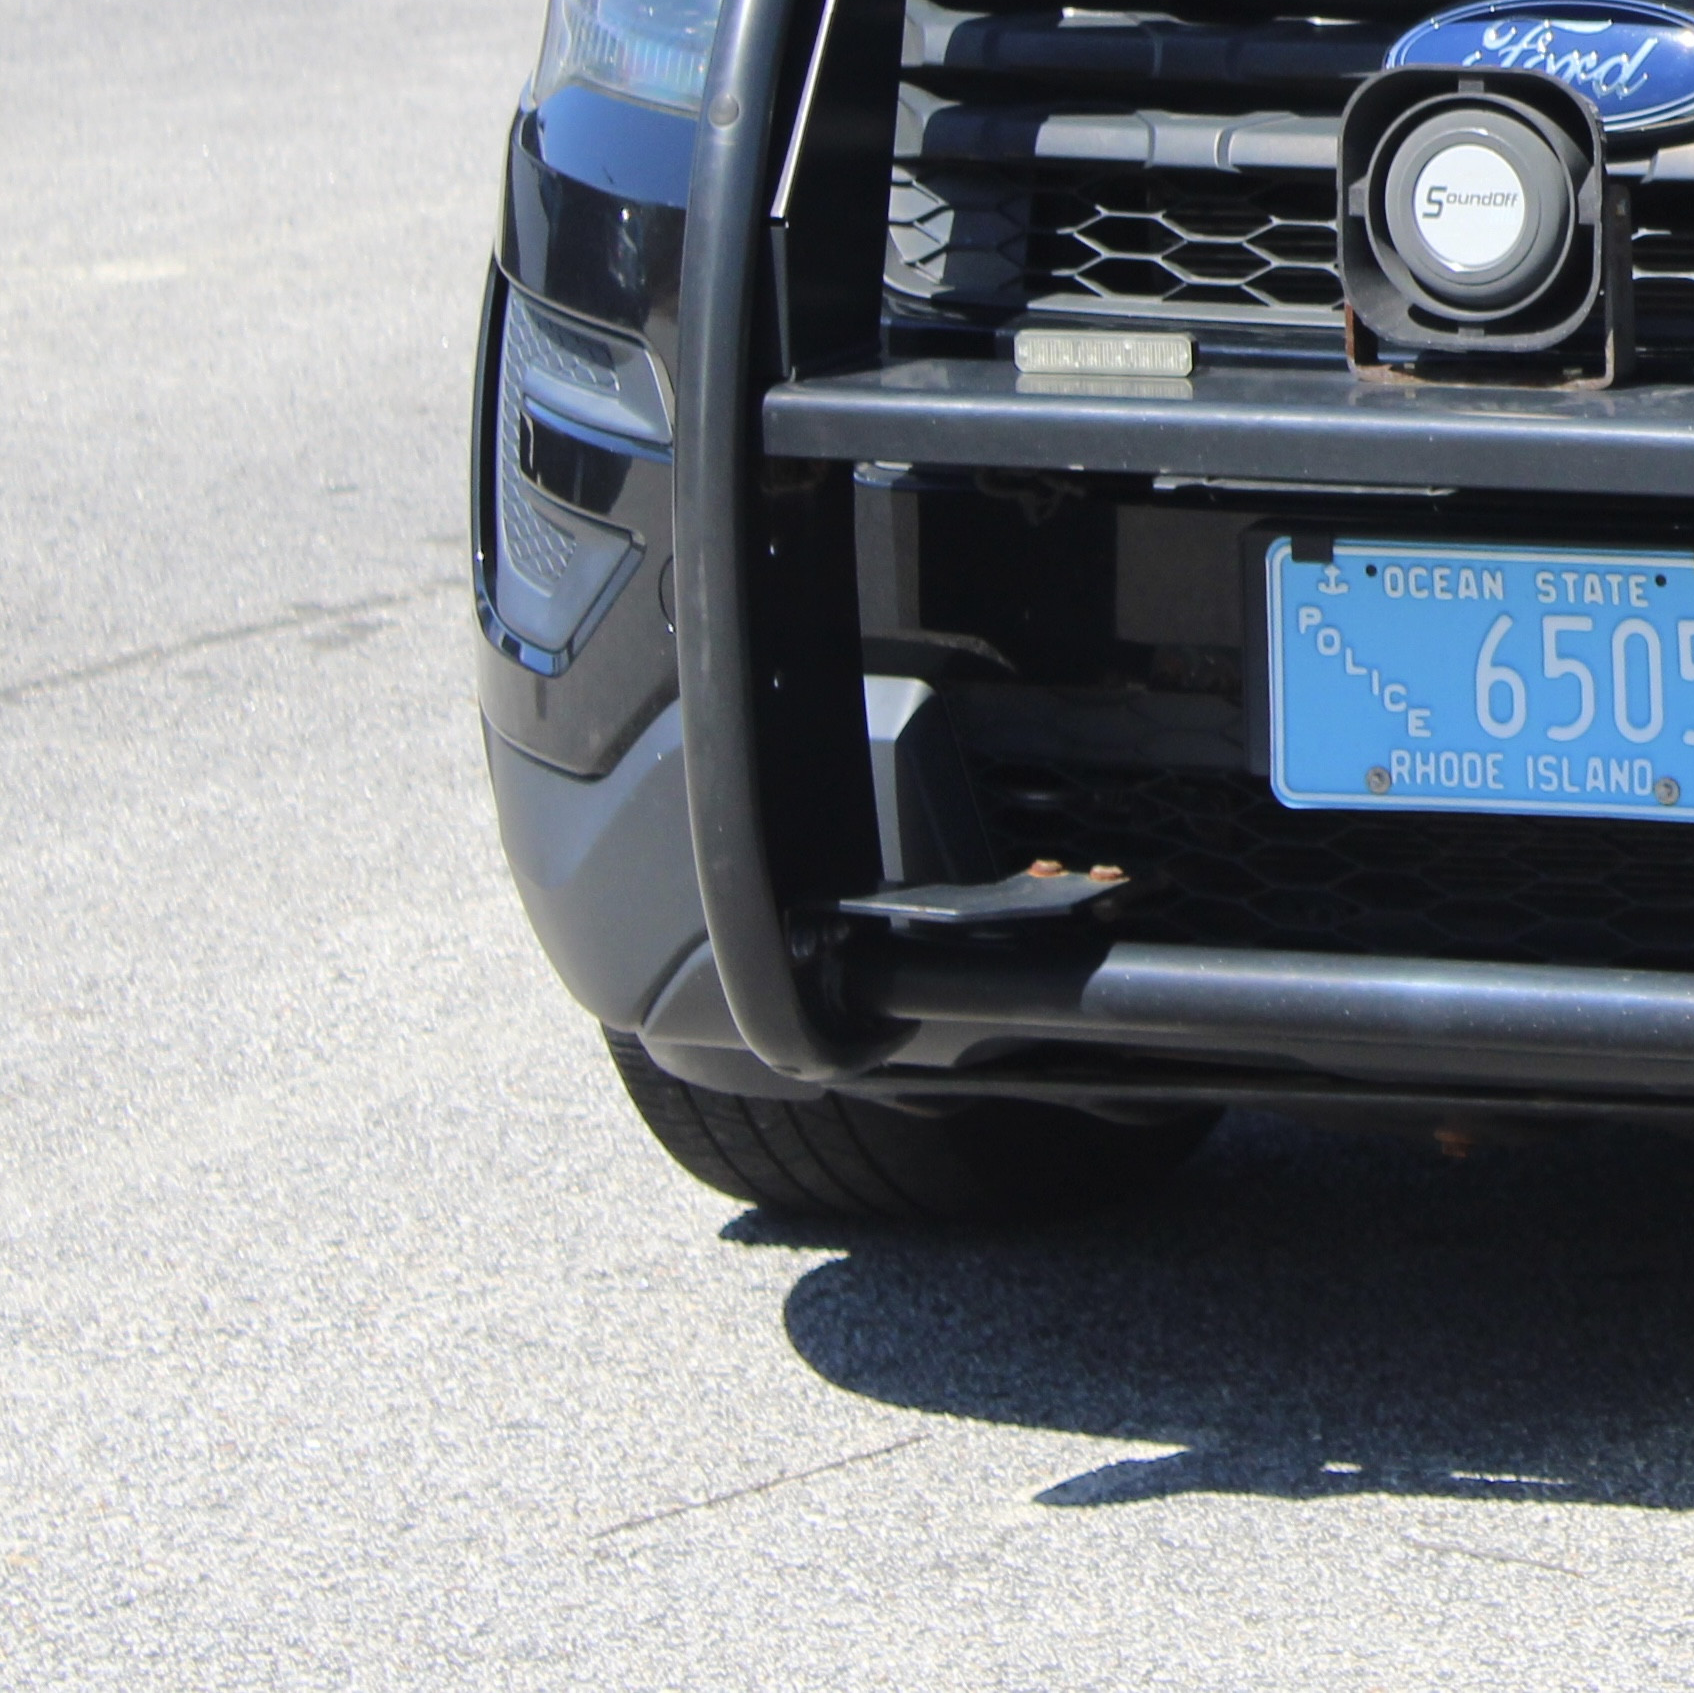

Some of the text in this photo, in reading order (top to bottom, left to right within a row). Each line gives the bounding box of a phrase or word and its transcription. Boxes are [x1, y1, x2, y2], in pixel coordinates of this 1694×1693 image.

[1422, 186, 1518, 219] SoundOff
[1383, 566, 1650, 608] OCEAN STATE
[1299, 606, 1432, 738] POLICE
[1390, 749, 1653, 798] RHODE ISLAND
